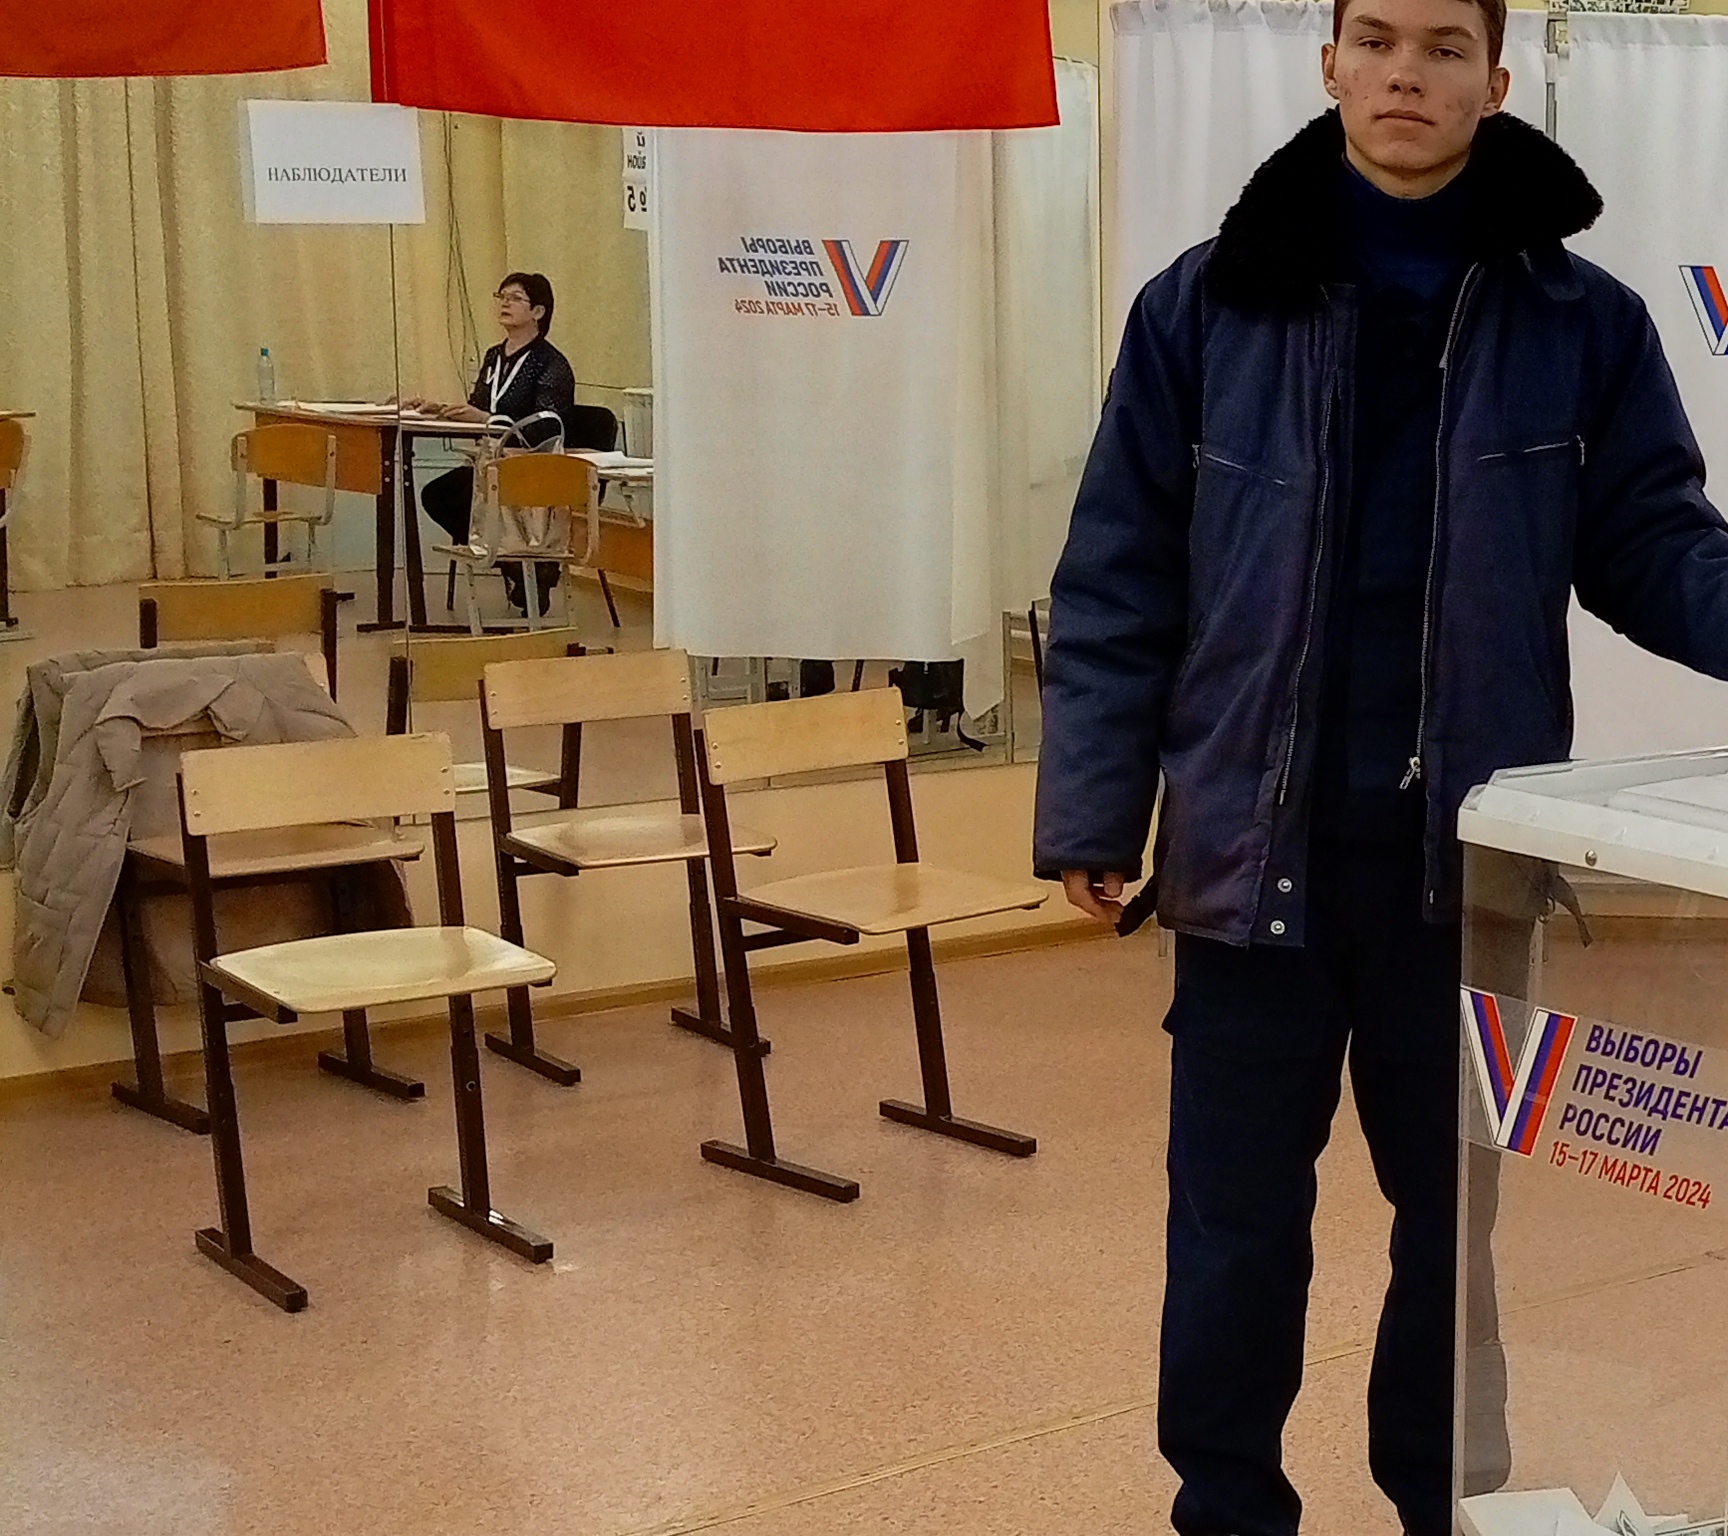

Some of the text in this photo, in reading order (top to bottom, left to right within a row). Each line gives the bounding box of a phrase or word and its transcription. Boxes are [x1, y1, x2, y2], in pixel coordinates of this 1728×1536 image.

[267, 167, 407, 185] НАБЛЮДАТЕЛИ
[1584, 1023, 1704, 1079] ВЫБОРЫ
[1558, 1102, 1663, 1157] РОССИИ
[1598, 1153, 1662, 1196] МАРТА
[1662, 1173, 1713, 1210] 2024
